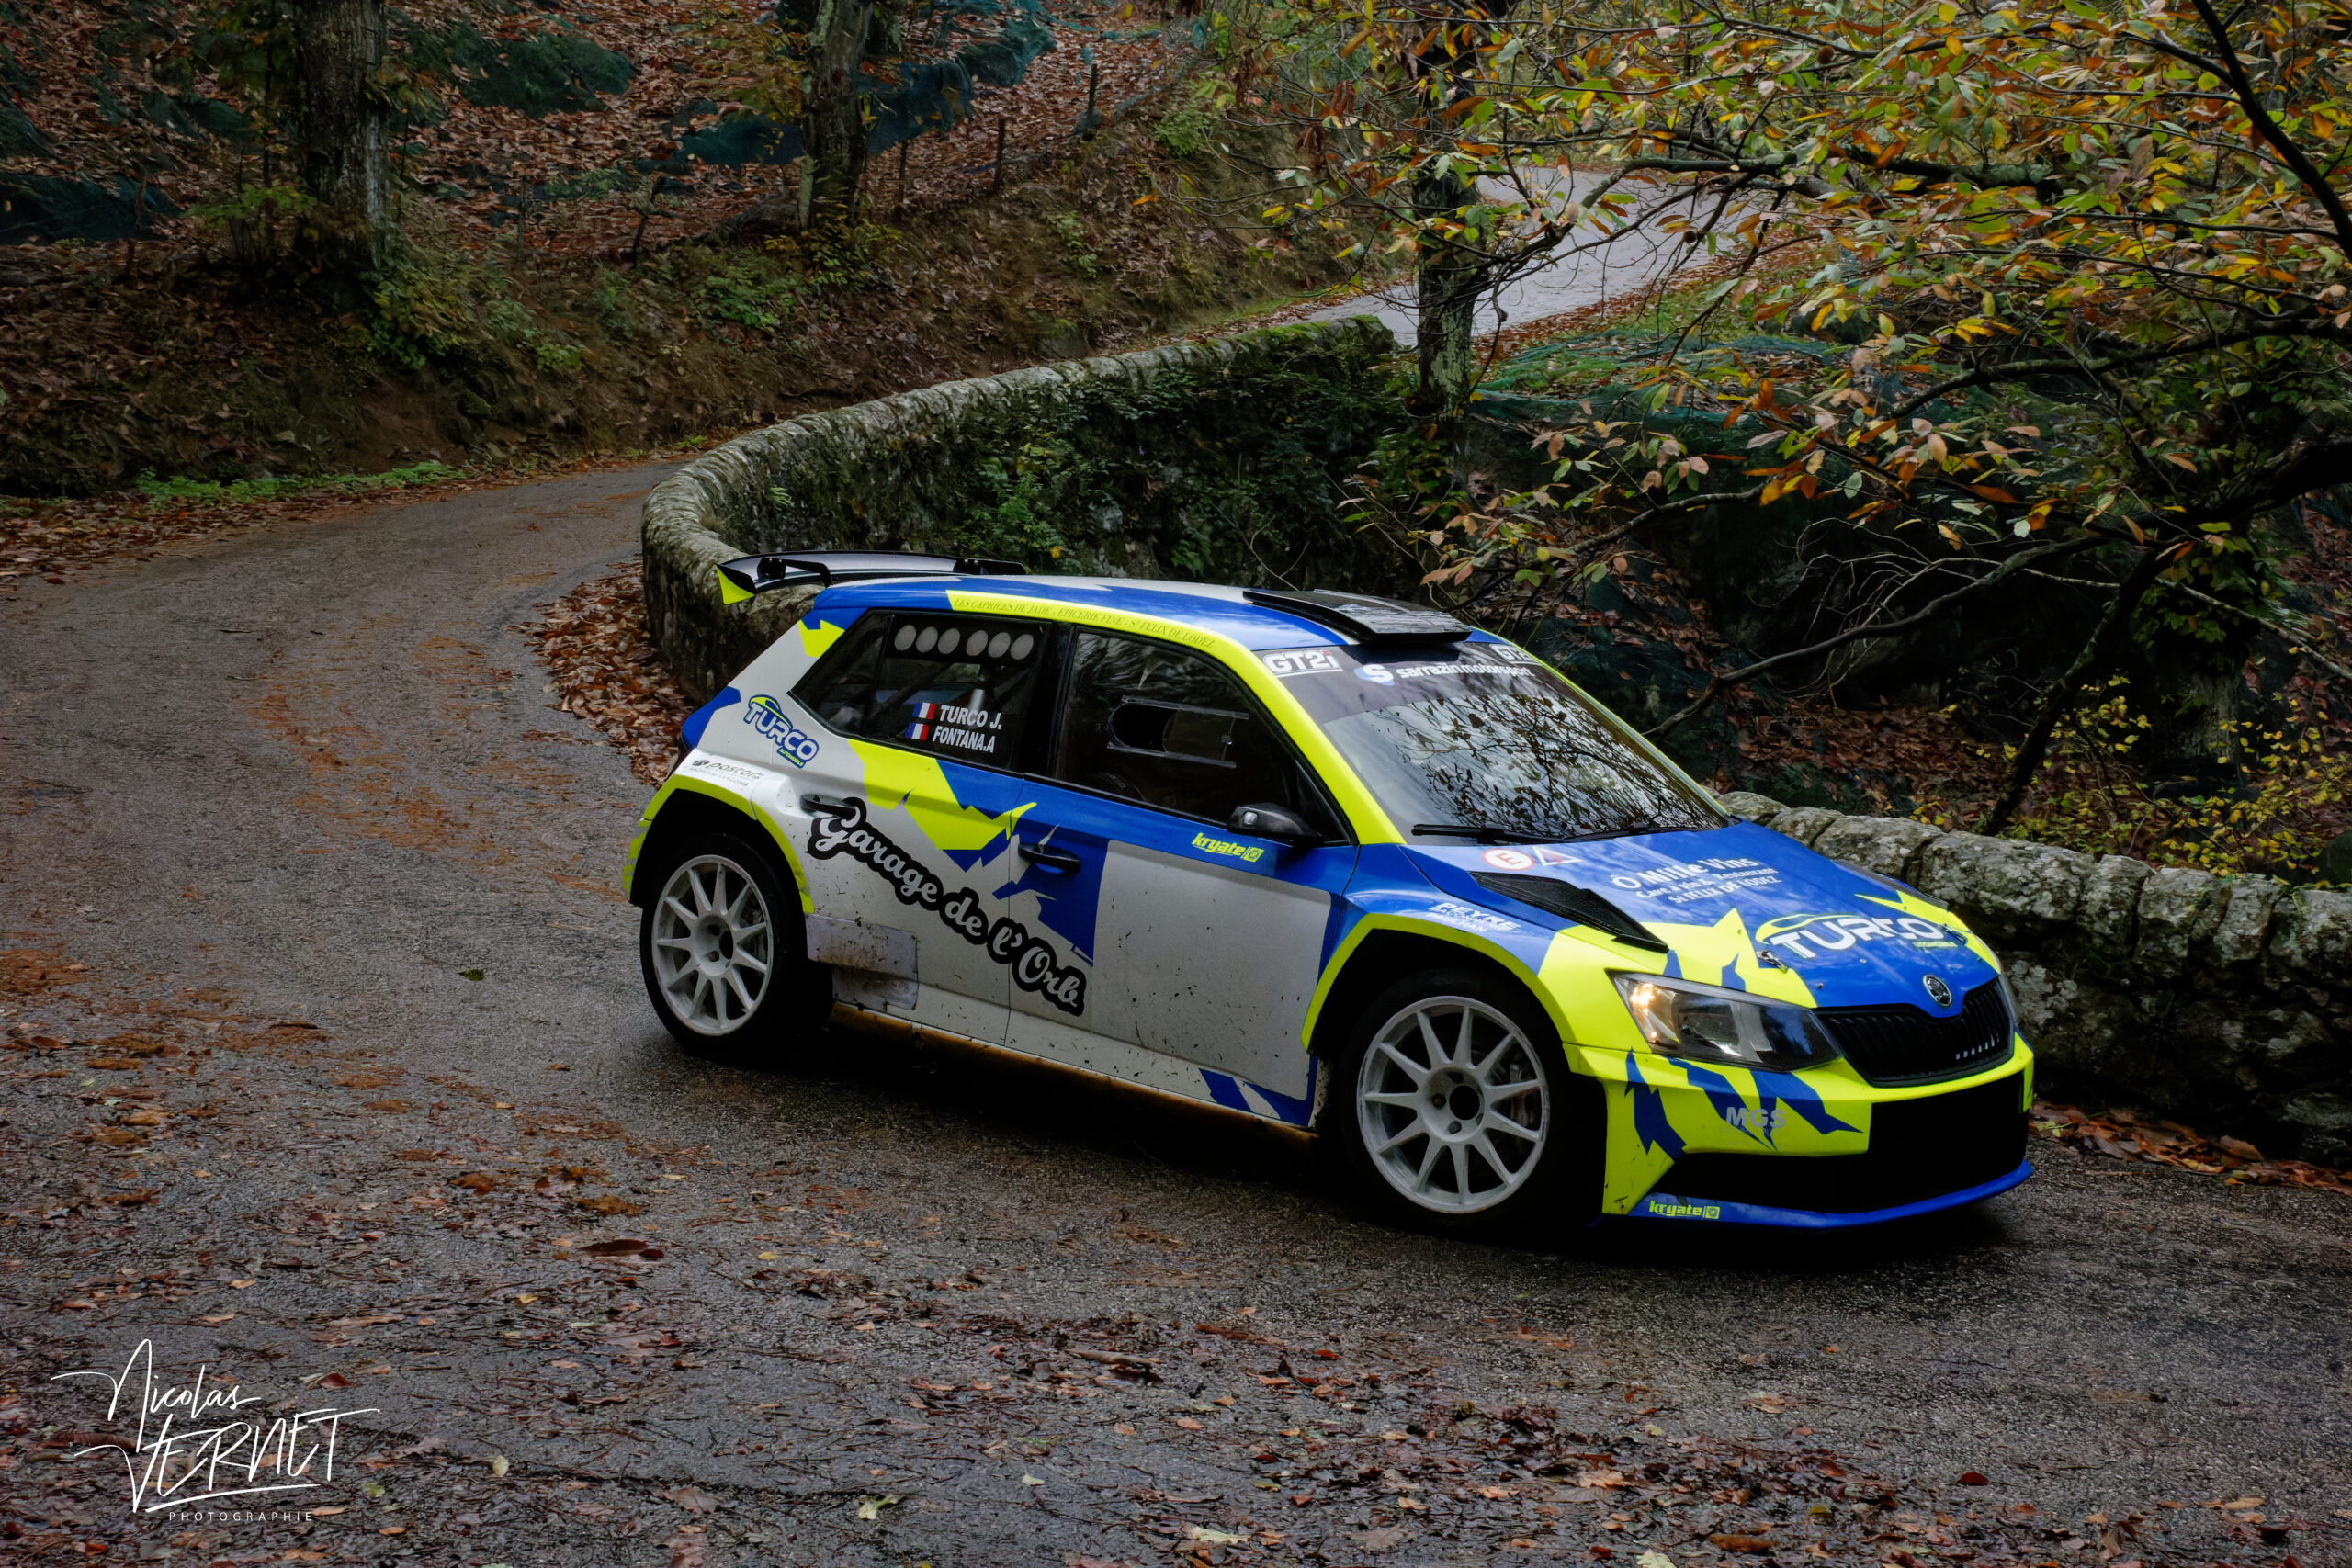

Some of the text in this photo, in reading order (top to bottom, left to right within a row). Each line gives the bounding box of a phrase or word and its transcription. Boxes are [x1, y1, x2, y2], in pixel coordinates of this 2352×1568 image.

[955, 598, 970, 607] LES
[971, 600, 1012, 610] CAPRICES
[1014, 604, 1026, 612] DE
[1099, 612, 1122, 626] FINE
[1169, 628, 1183, 638] DE
[1183, 631, 1216, 649] LODEZ
[1263, 649, 1337, 673] GT2i
[939, 705, 1002, 730] TURCO J.
[745, 703, 817, 761] TURCO
[932, 725, 996, 753] FONTANA.A
[1192, 832, 1246, 856] kryate
[812, 803, 940, 904] Garage
[944, 896, 984, 938] de
[1635, 886, 1671, 899] Cave
[1712, 867, 1780, 881] Restaurant
[1636, 863, 1708, 884] Mille
[1697, 858, 1759, 870] Vins
[1668, 875, 1782, 904] St FELIX DE LODEZ
[1770, 916, 1946, 959] TURCO
[1725, 1106, 1786, 1129] MGS
[1649, 1201, 1703, 1217] kryate
